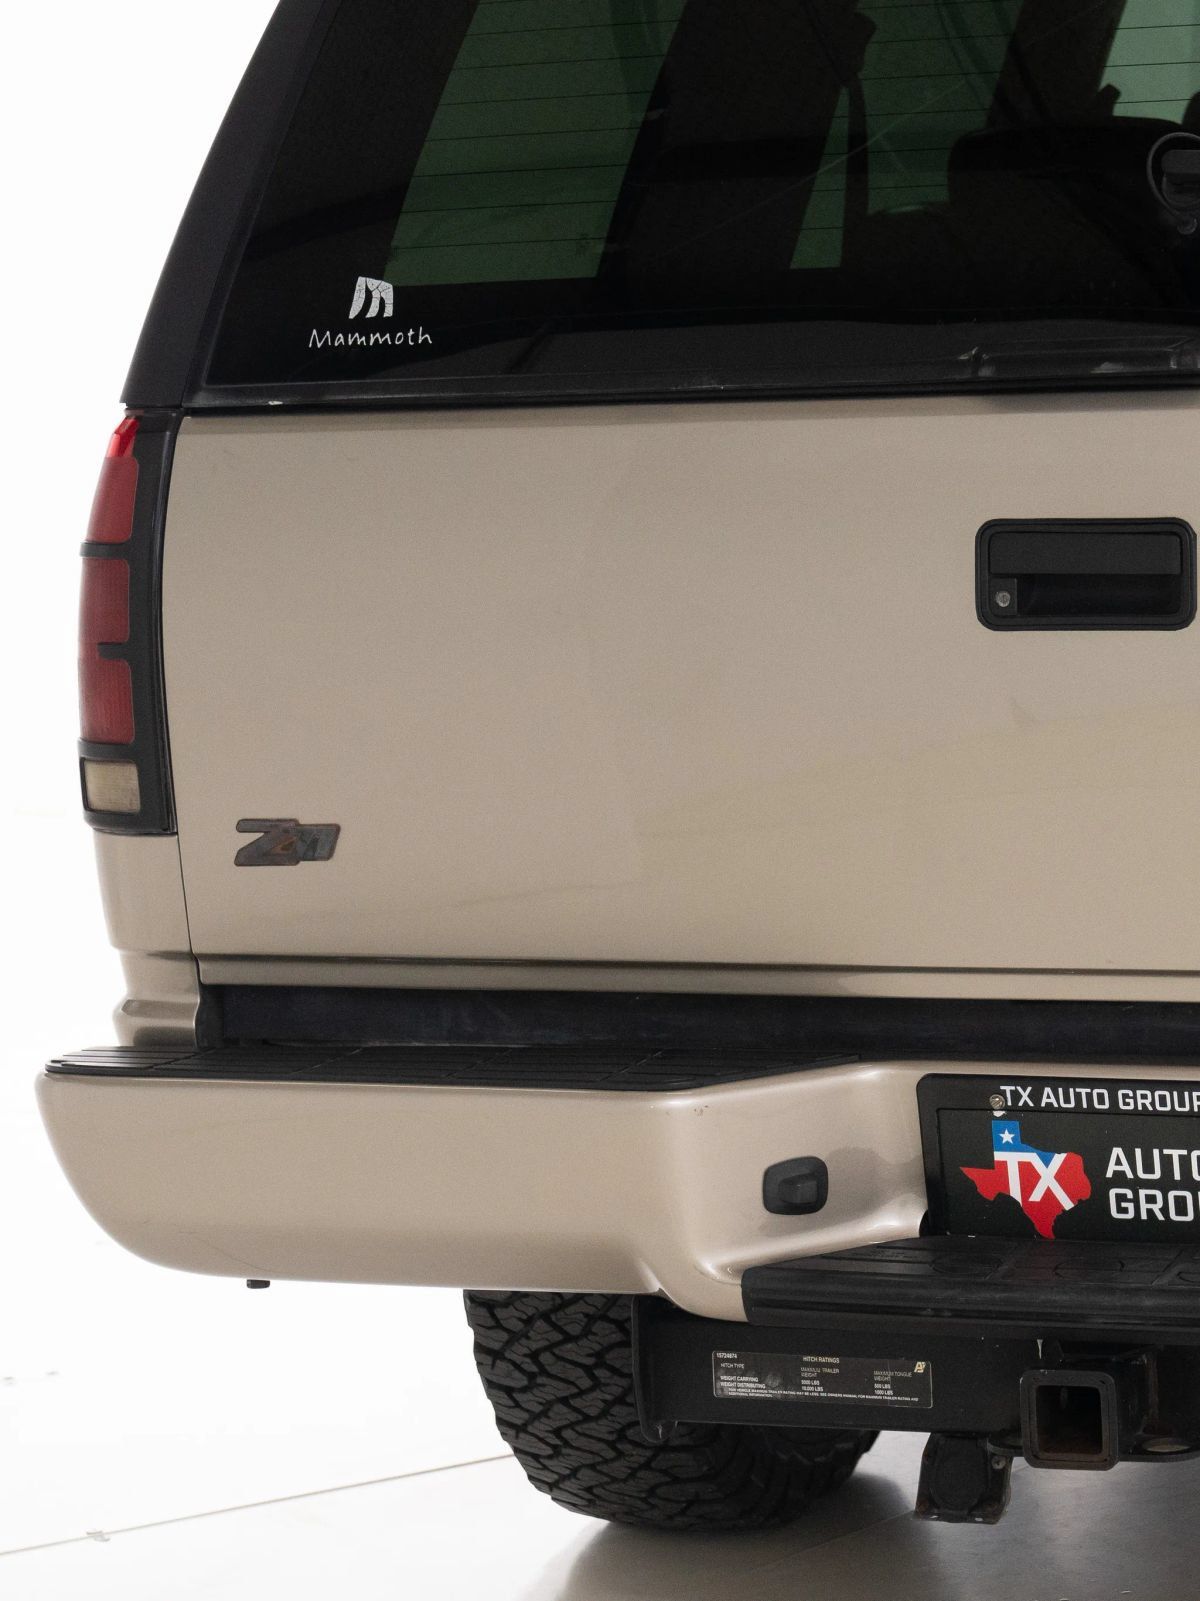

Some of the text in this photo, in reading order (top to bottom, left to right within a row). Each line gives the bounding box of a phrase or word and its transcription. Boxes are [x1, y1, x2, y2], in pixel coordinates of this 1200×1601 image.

[308, 326, 433, 348] Mammoth
[1000, 1086, 1034, 1107] TX
[1041, 1087, 1109, 1110] AUTO
[994, 1151, 1074, 1211] TX
